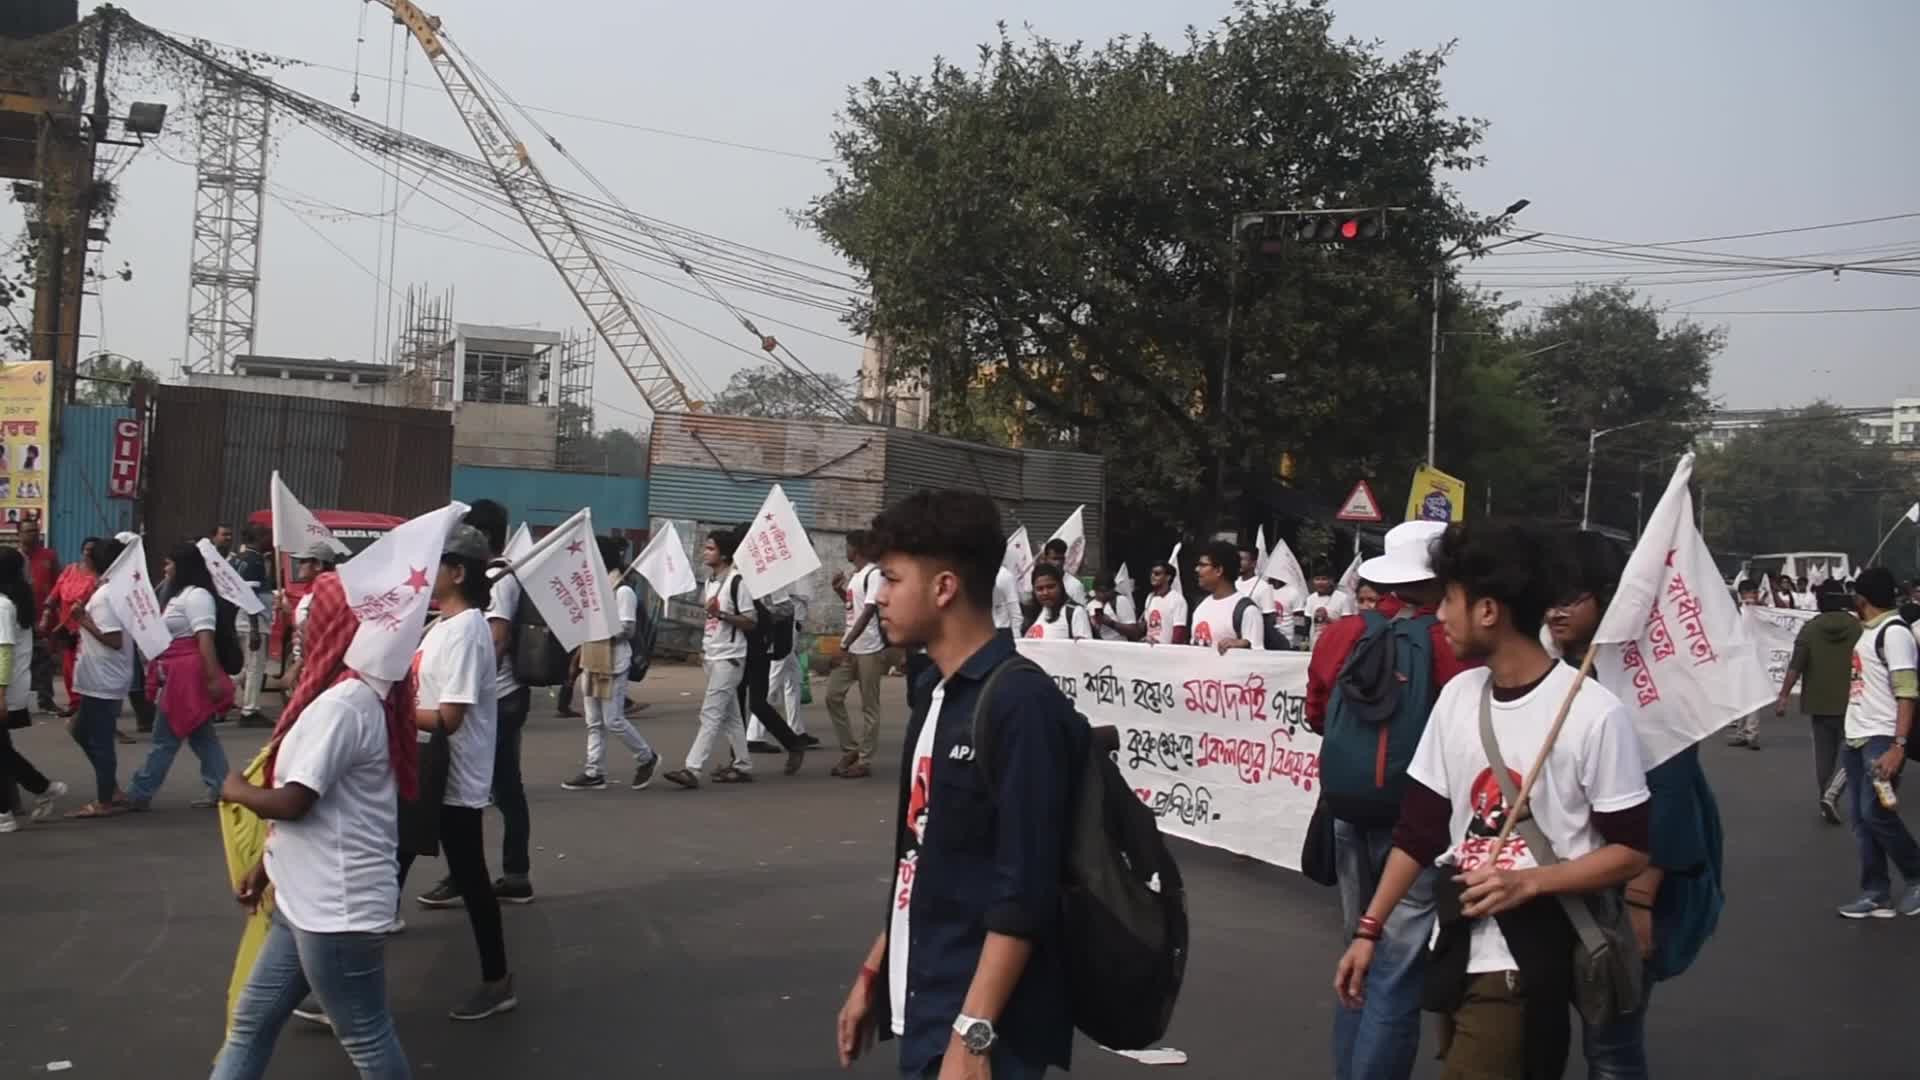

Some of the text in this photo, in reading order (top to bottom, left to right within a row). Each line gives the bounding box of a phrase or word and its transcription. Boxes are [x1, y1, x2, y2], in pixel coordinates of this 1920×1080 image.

[112, 422, 139, 494] CITU
[1666, 574, 1718, 667] স্বাধীনতা
[1083, 665, 1125, 707] শহীদ
[1131, 678, 1175, 714] হয়েও
[1183, 672, 1267, 720] মতাদর্শই
[1197, 732, 1266, 784] একলব্যের
